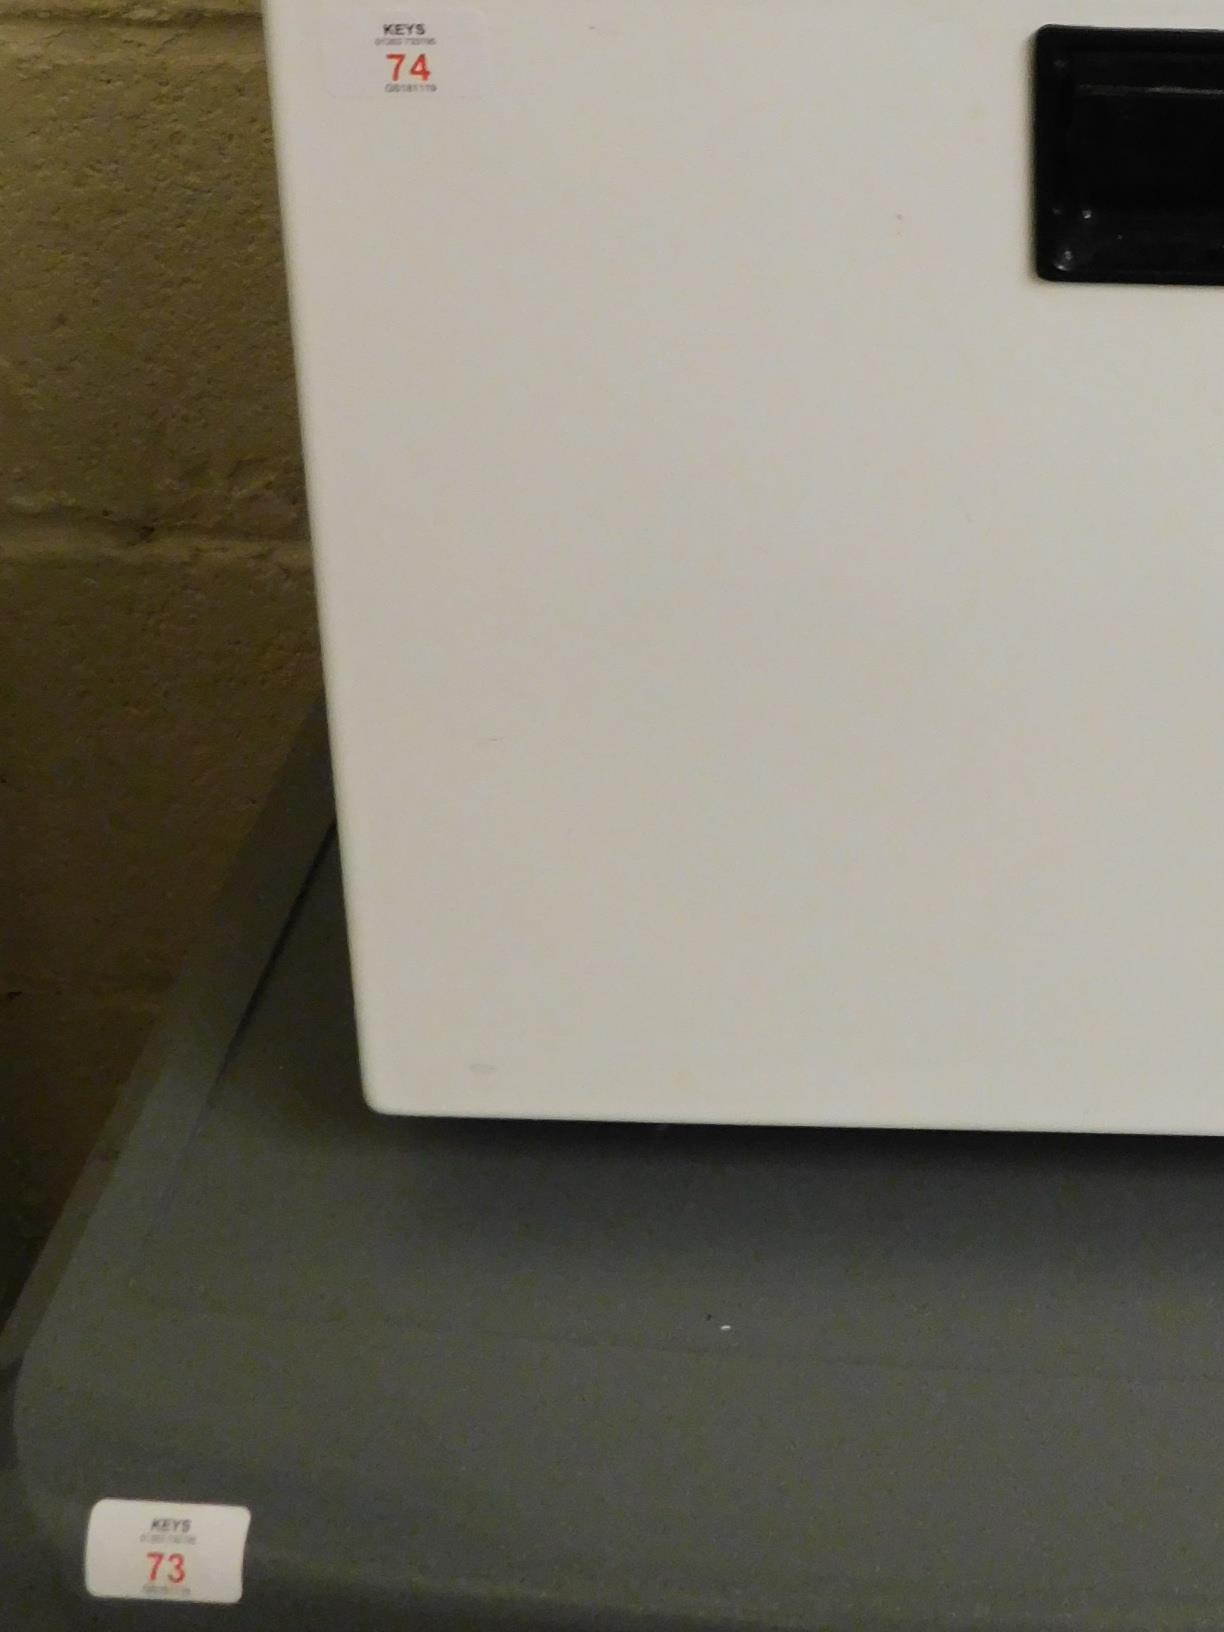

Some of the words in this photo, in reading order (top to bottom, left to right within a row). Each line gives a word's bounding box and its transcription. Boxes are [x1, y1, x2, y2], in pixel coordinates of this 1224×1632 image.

[383, 24, 426, 35] KEYS
[386, 53, 431, 81] 74
[151, 1518, 192, 1533] KEYS
[146, 1551, 187, 1585] 73
